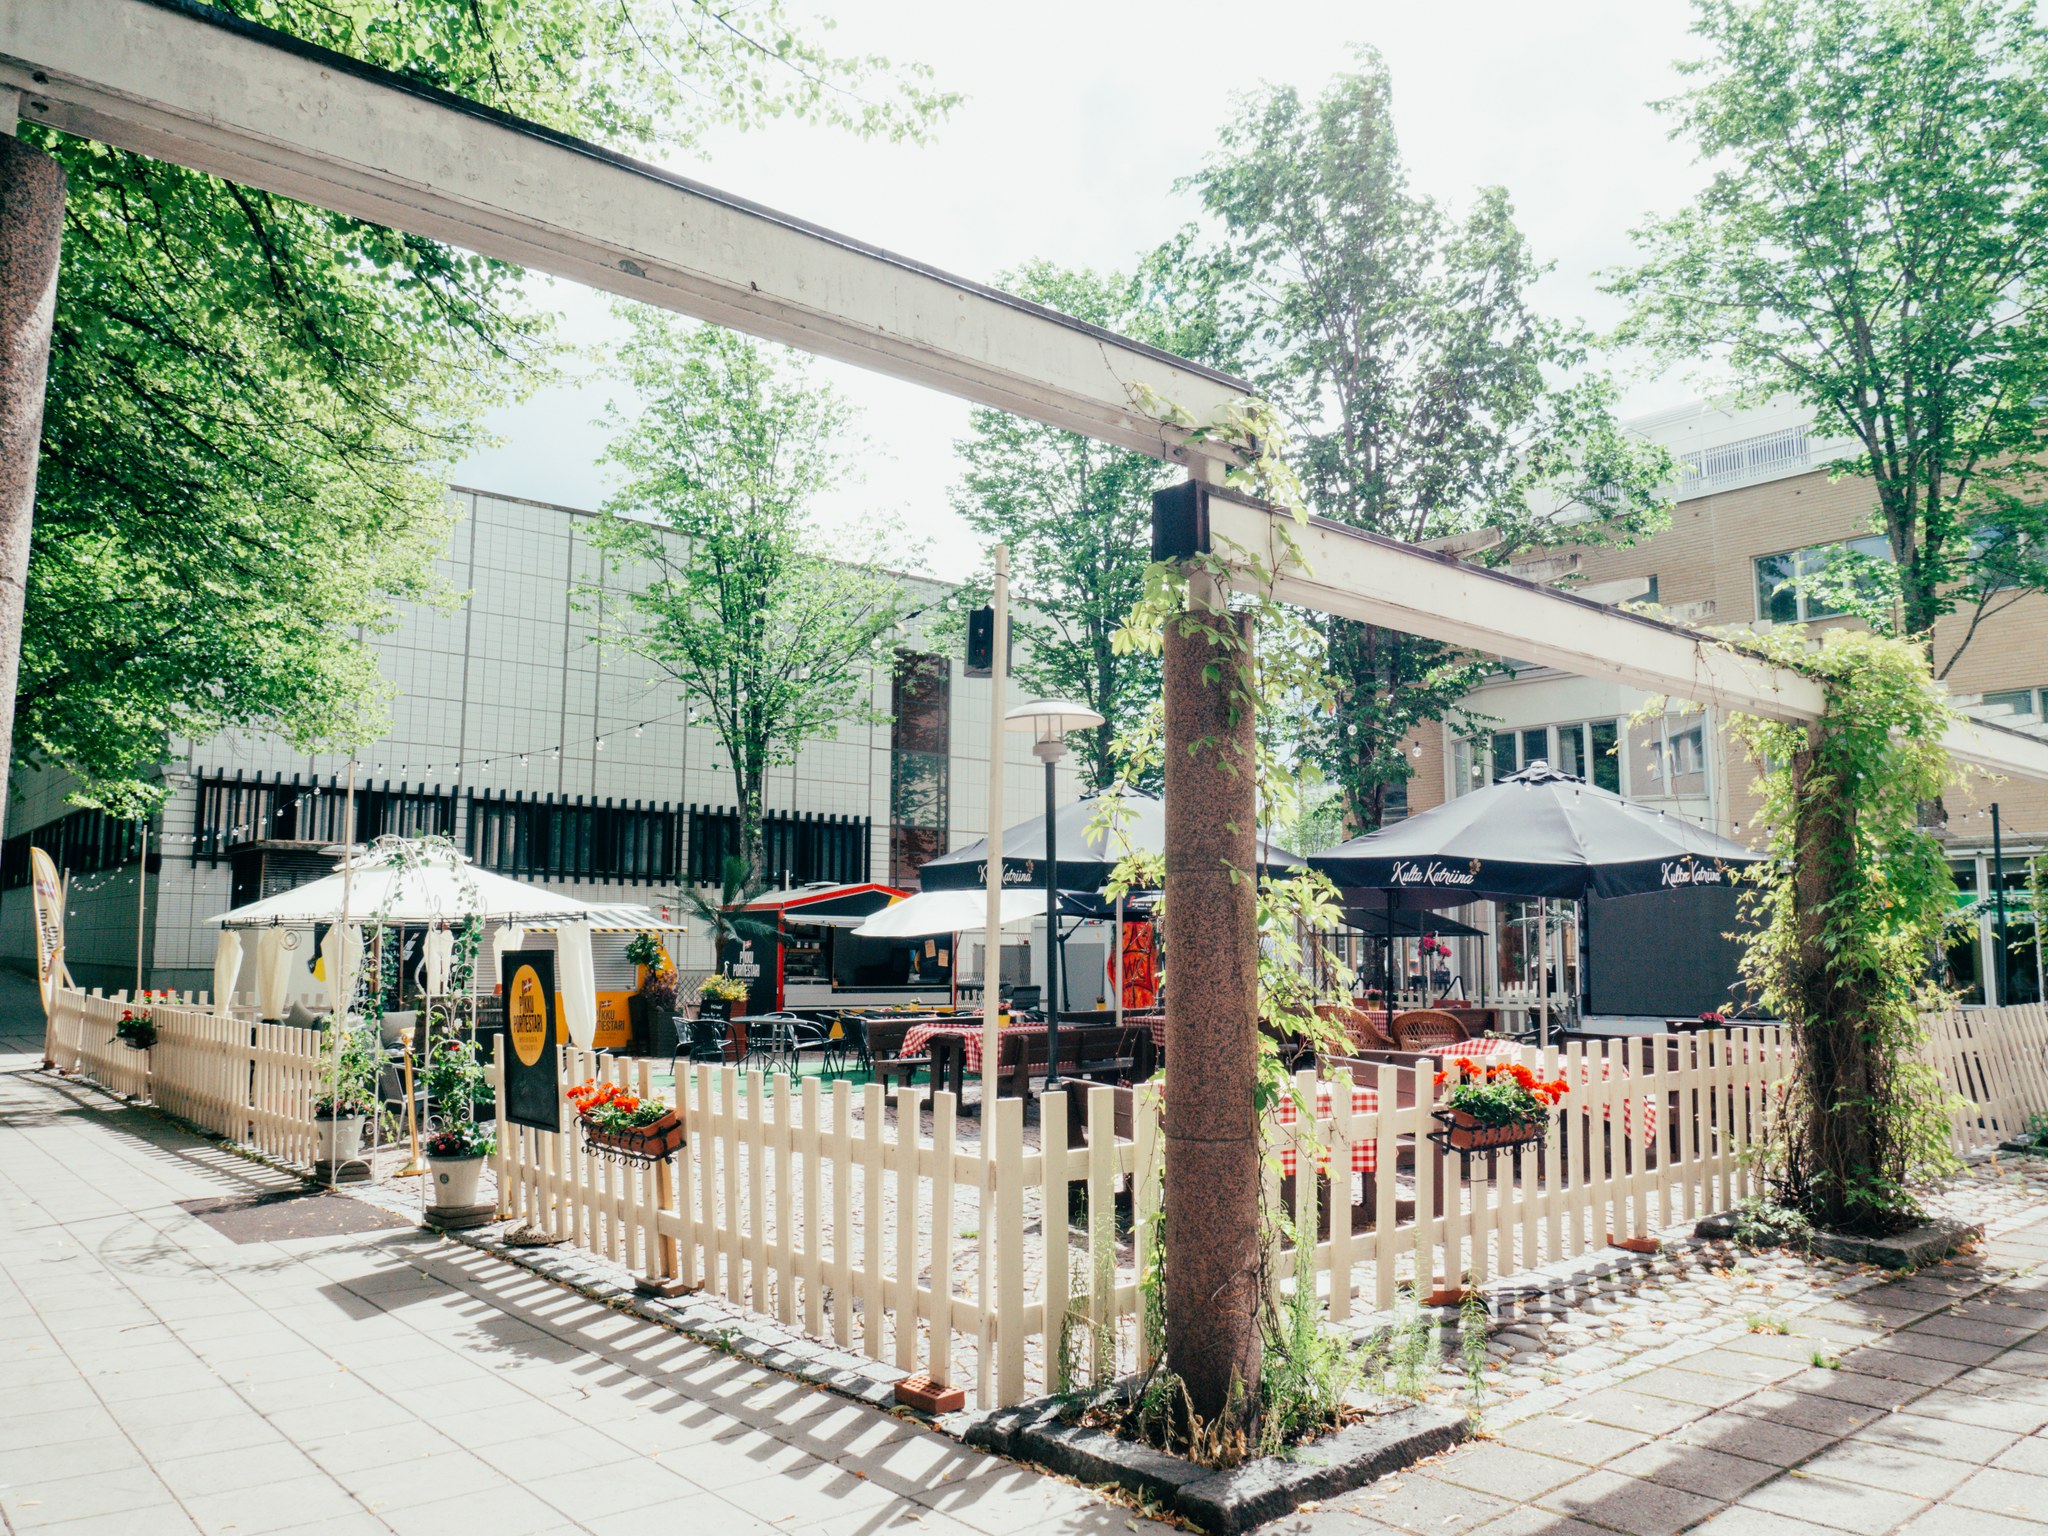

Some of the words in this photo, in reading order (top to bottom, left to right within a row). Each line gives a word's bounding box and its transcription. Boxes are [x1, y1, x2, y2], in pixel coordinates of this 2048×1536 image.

[1391, 861, 1423, 886] Kulta
[1423, 862, 1474, 887] Katriina
[1691, 860, 1721, 886] Katriina
[1122, 957, 1146, 981] WC
[519, 995, 534, 1014] PIKKU
